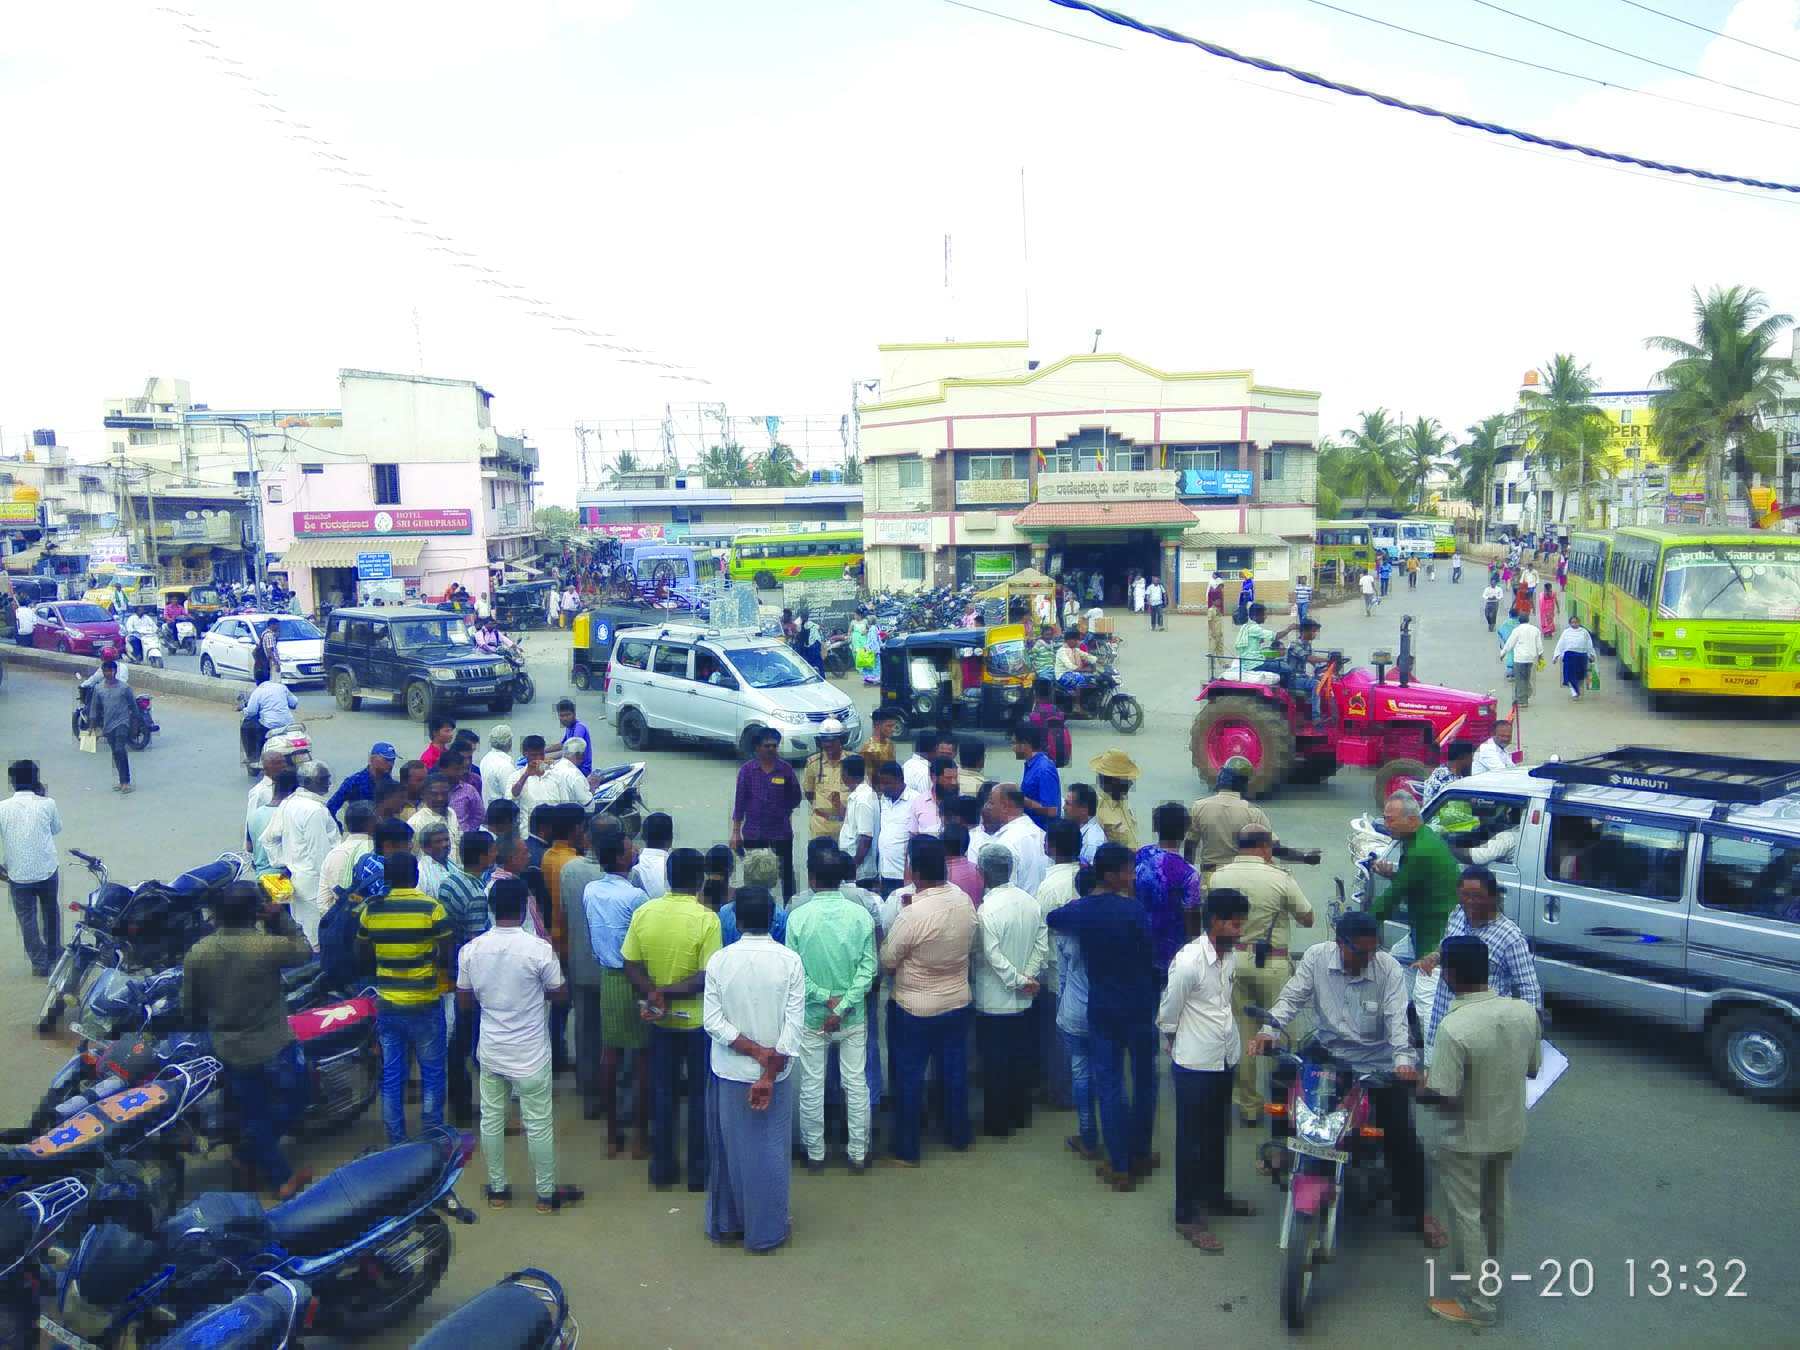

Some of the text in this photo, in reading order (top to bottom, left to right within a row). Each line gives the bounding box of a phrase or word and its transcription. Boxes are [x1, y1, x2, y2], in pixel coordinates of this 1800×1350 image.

[1112, 480, 1129, 494] ಬಸ್
[304, 520, 316, 532] ಶ್ರೀ
[396, 519, 468, 528] SRI GURUPRASAD
[1622, 776, 1669, 790] MARUTI
